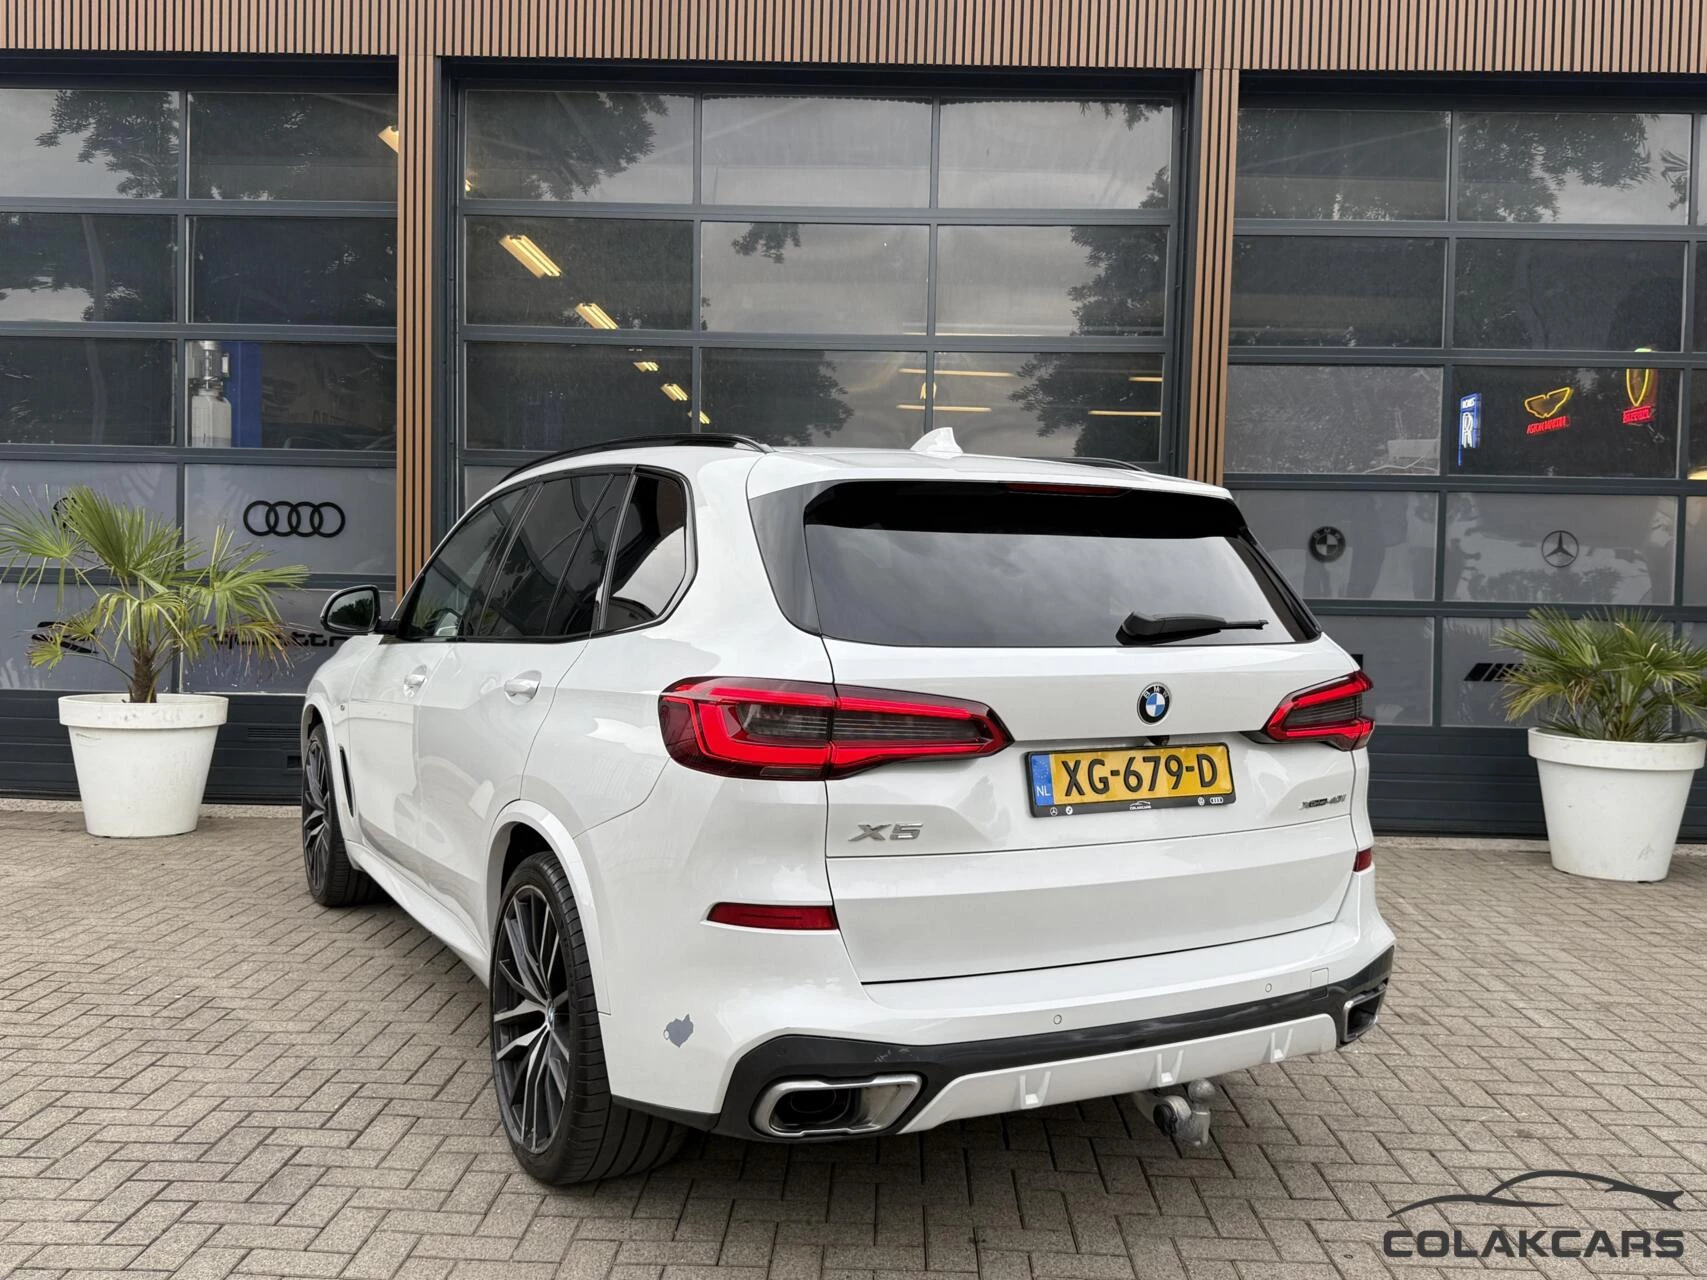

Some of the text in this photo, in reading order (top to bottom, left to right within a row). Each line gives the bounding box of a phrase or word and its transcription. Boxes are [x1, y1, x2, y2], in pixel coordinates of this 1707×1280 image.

[1143, 686, 1169, 699] BMW
[1061, 753, 1218, 797] XG-679-D
[1036, 785, 1051, 797] NL
[848, 823, 923, 841] X5
